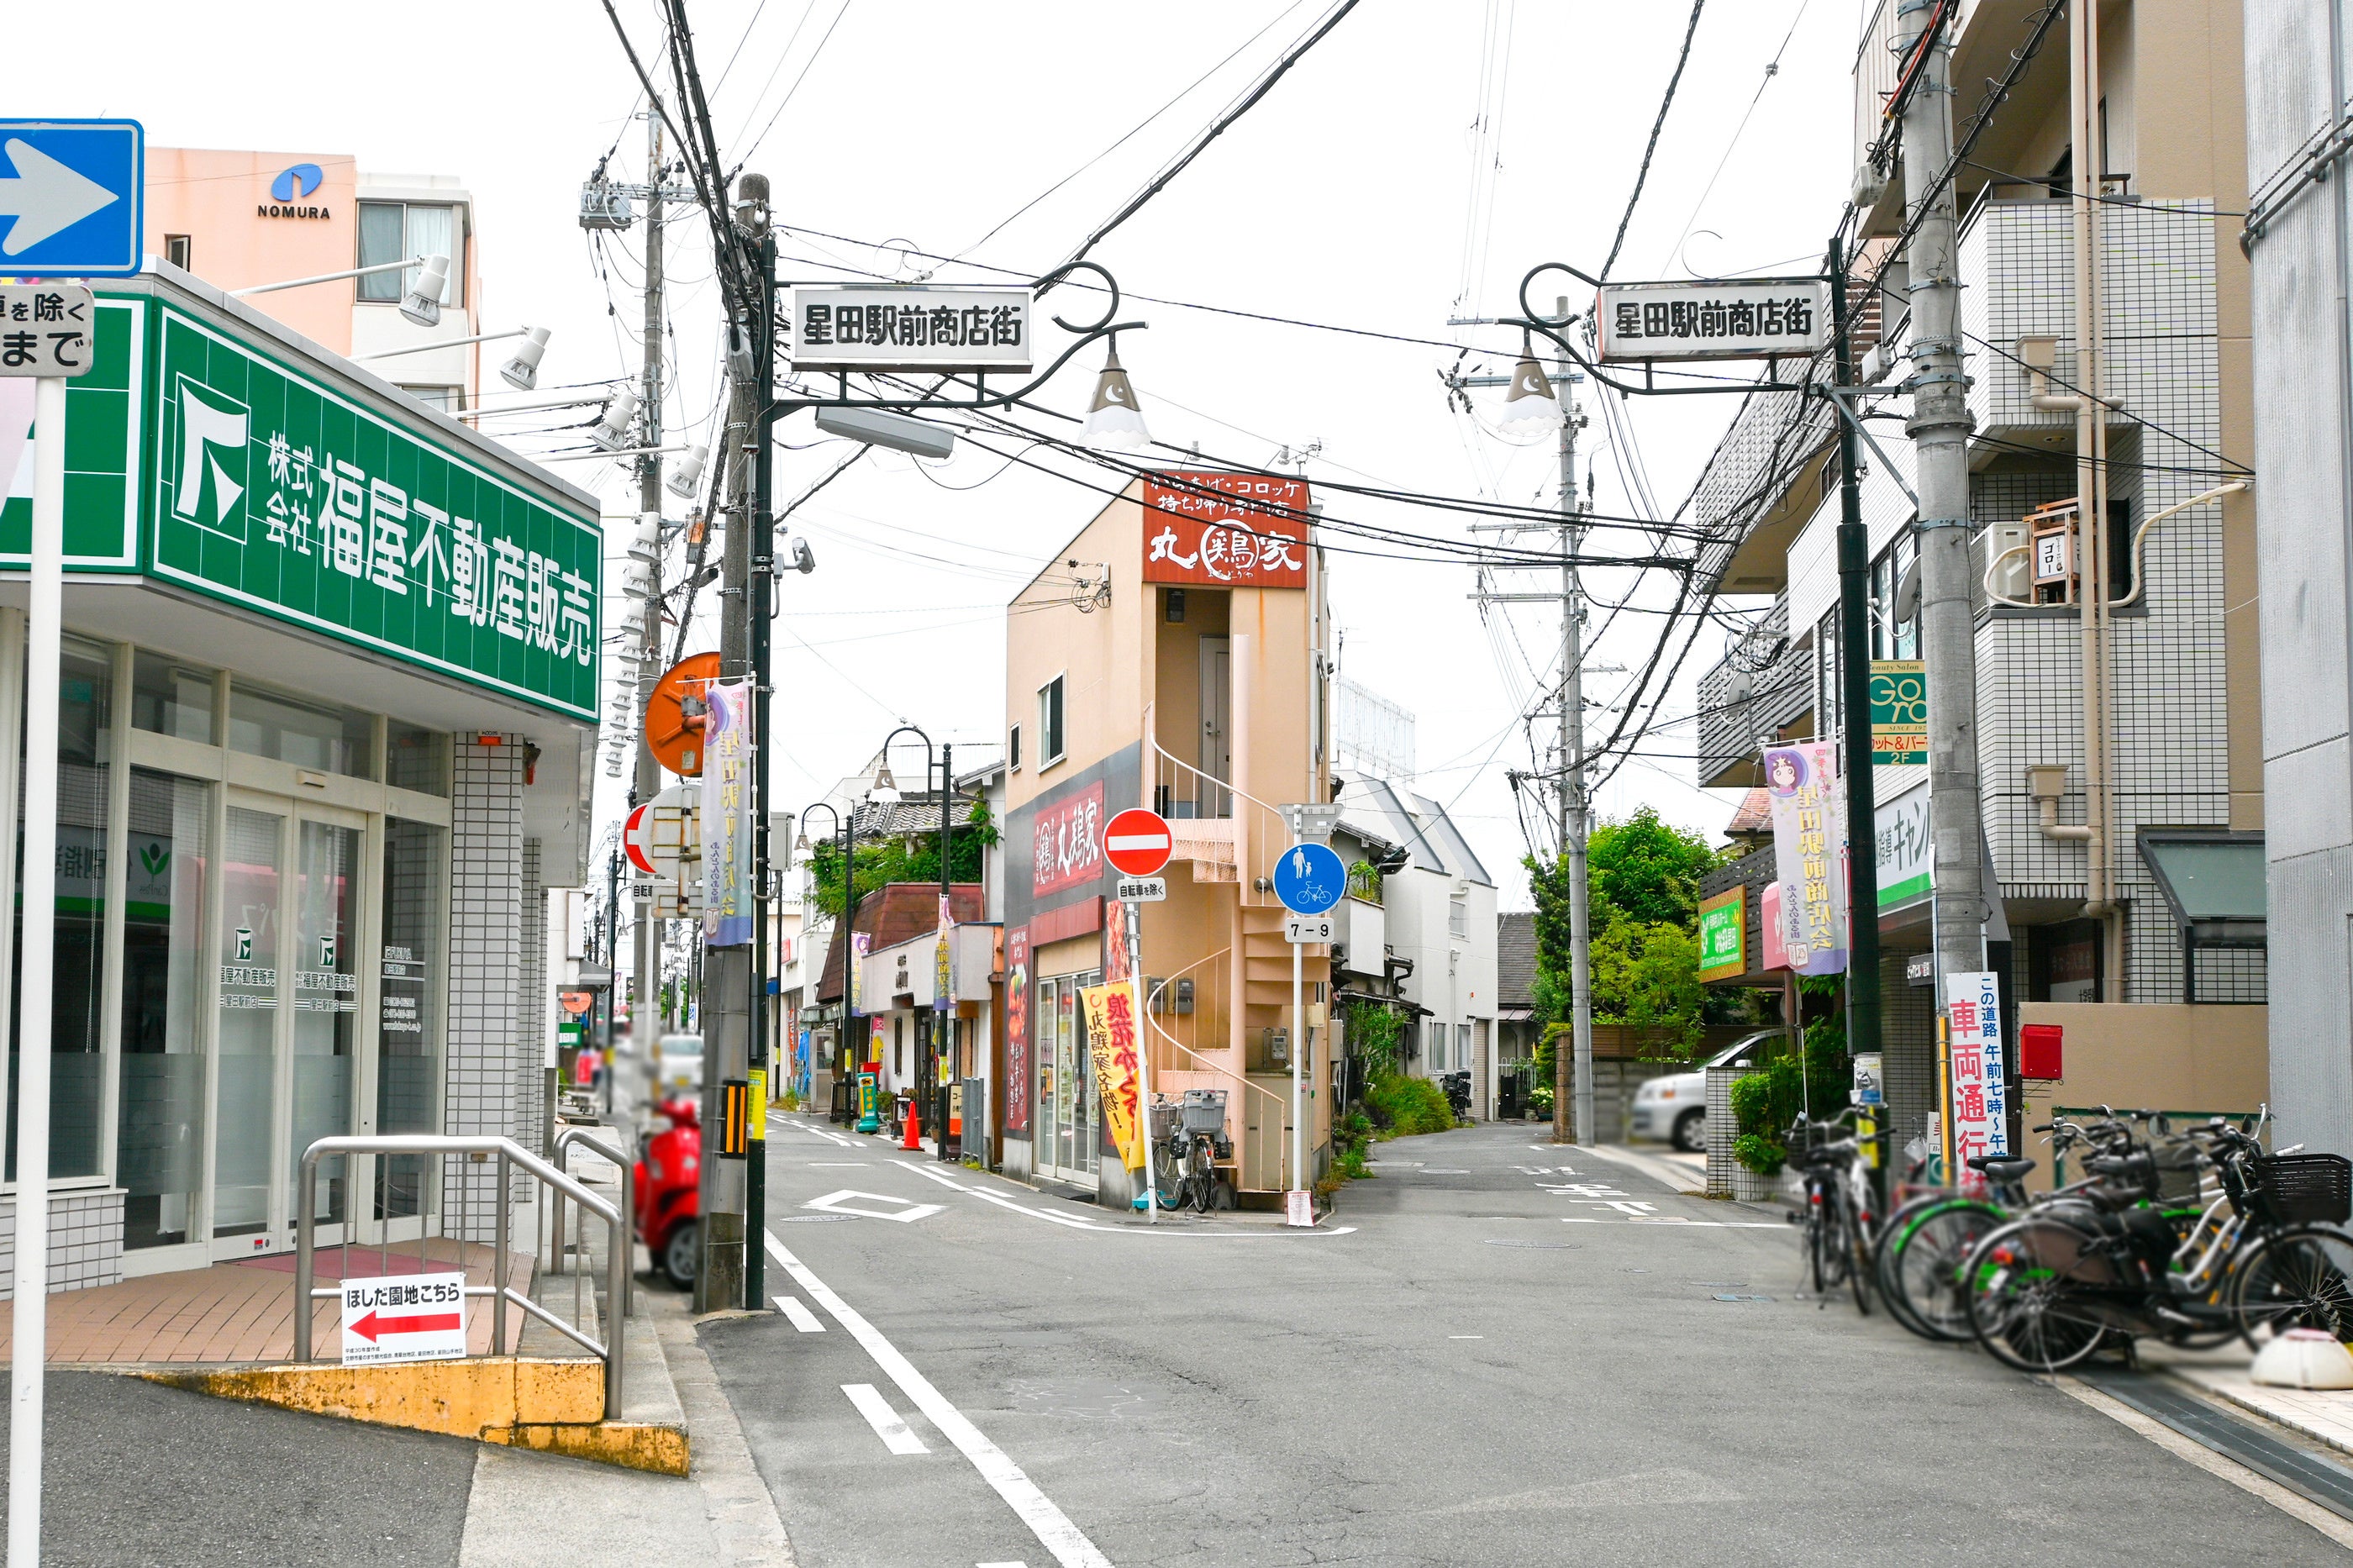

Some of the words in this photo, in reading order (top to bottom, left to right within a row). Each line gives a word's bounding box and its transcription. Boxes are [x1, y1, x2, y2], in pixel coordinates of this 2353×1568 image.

[257, 205, 330, 219] NOMURA
[0, 292, 85, 322] を除く
[803, 304, 1022, 347] 星田駅前商店街
[1615, 298, 1813, 339] 星田駅前商店街
[2, 329, 84, 367] まで
[266, 429, 314, 499] 株式
[265, 491, 313, 556] 会社
[317, 451, 593, 667] 福屋不動産販売
[1149, 524, 1303, 573] 丸鶏家
[1891, 752, 1910, 765] 2F
[1119, 883, 1164, 897] 自転車を除く
[303, 972, 355, 992] 福屋不動産販売
[1980, 976, 1999, 1039] この道路
[1984, 1044, 2008, 1156] 午前七時～午
[346, 1282, 461, 1308] ほしだ園地こちら
